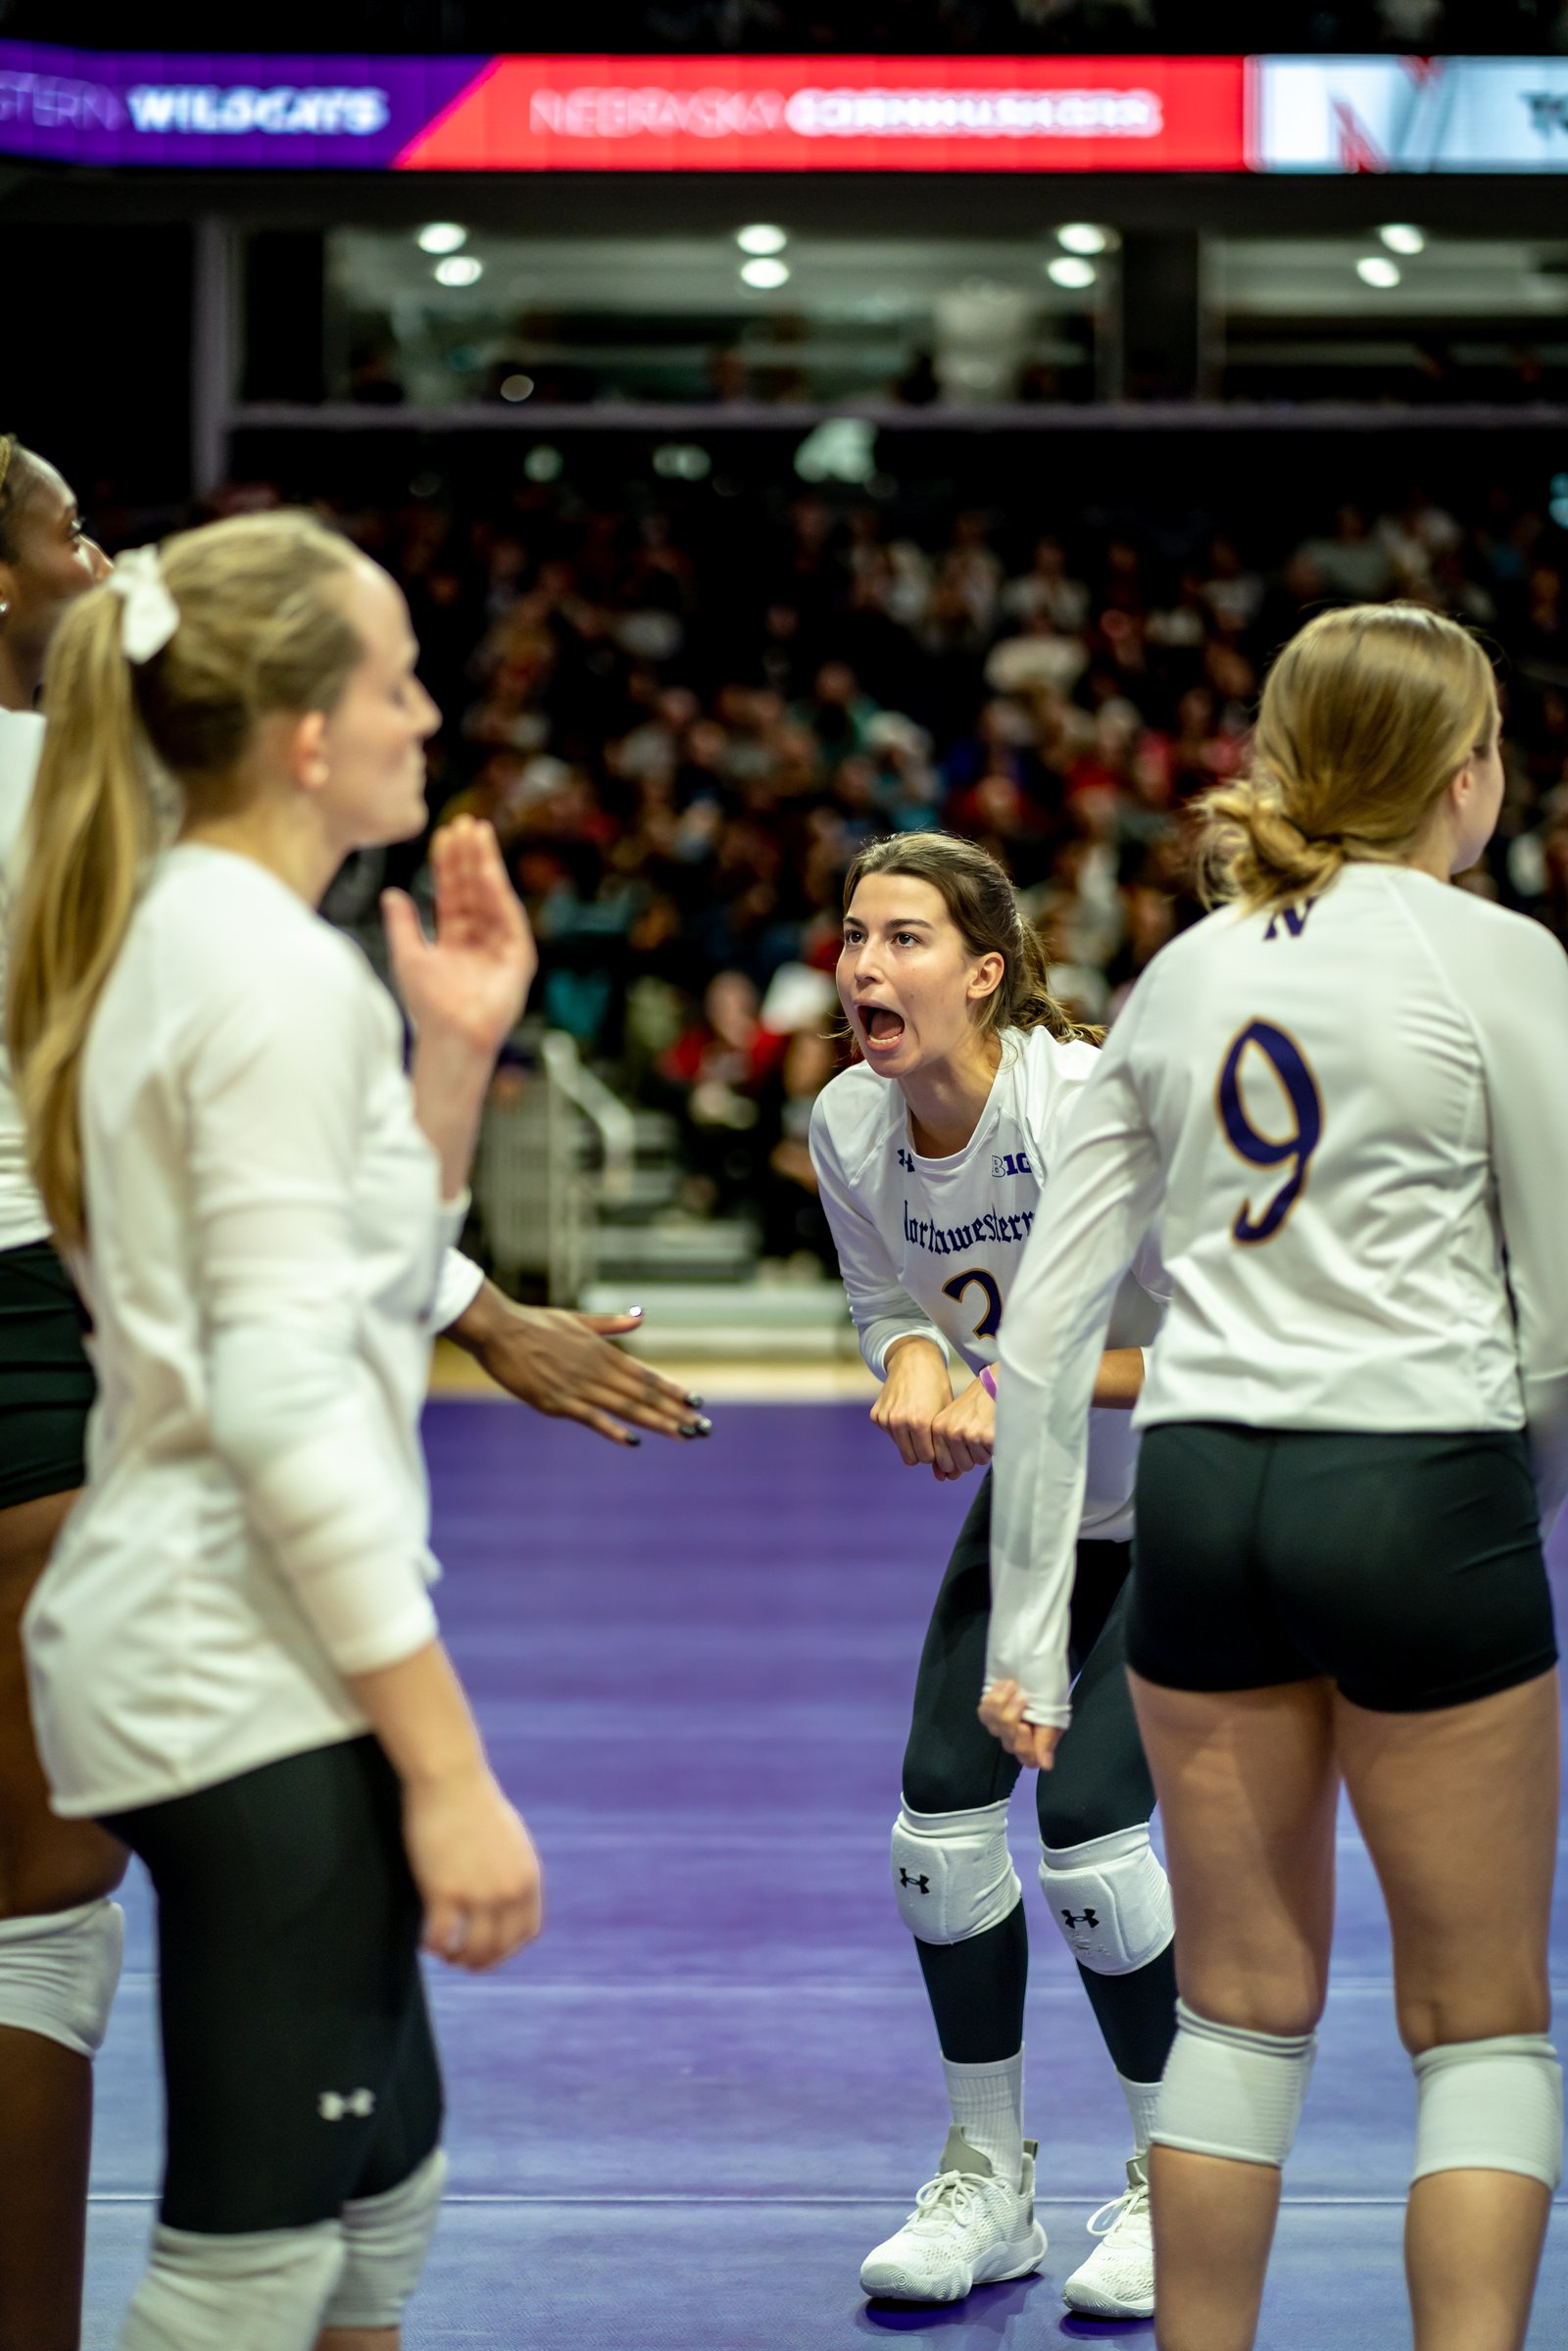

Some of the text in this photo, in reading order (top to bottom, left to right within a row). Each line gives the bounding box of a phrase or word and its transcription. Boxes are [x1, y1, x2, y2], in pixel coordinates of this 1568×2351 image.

[127, 84, 390, 135] WILDCATS
[529, 87, 787, 137] NEBRASKA
[1262, 896, 1317, 942] N
[1215, 1015, 1325, 1248] 9
